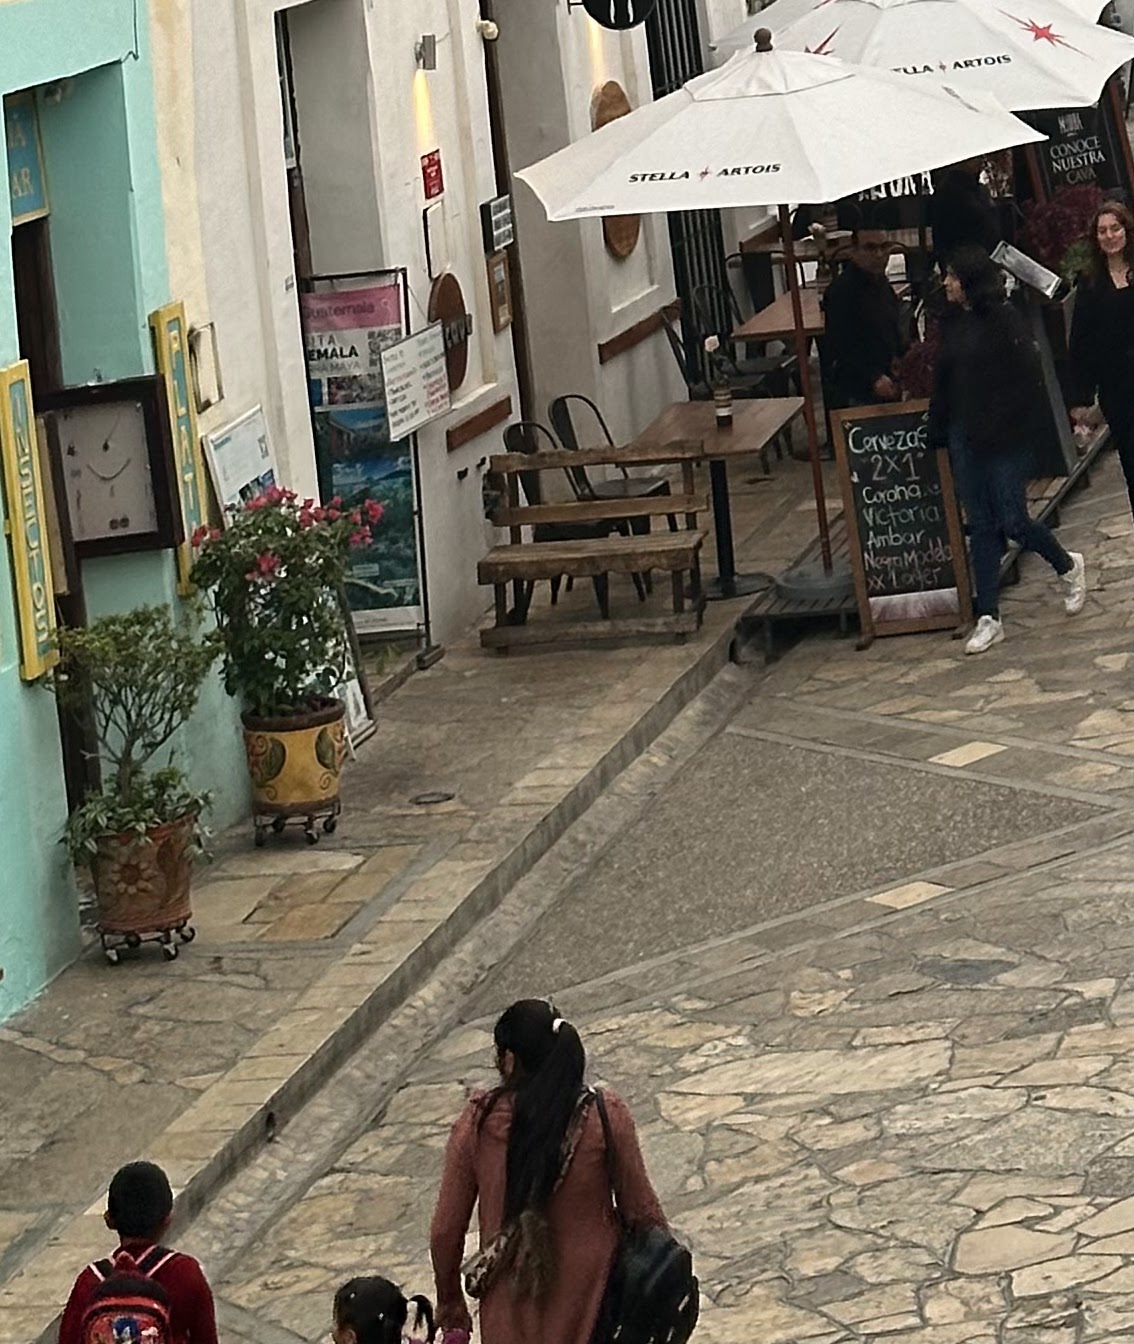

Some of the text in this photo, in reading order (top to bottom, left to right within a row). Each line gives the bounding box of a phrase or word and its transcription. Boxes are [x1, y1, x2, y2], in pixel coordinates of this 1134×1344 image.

[953, 54, 1012, 70] ARTOIS
[1050, 136, 1101, 159] CONOCE
[628, 163, 781, 183] STELLA ARTOIS
[1052, 150, 1106, 173] NUESTRA
[15, 395, 49, 643] INSECTOS
[863, 504, 941, 527] Victoria
[867, 526, 925, 549] Ambar
